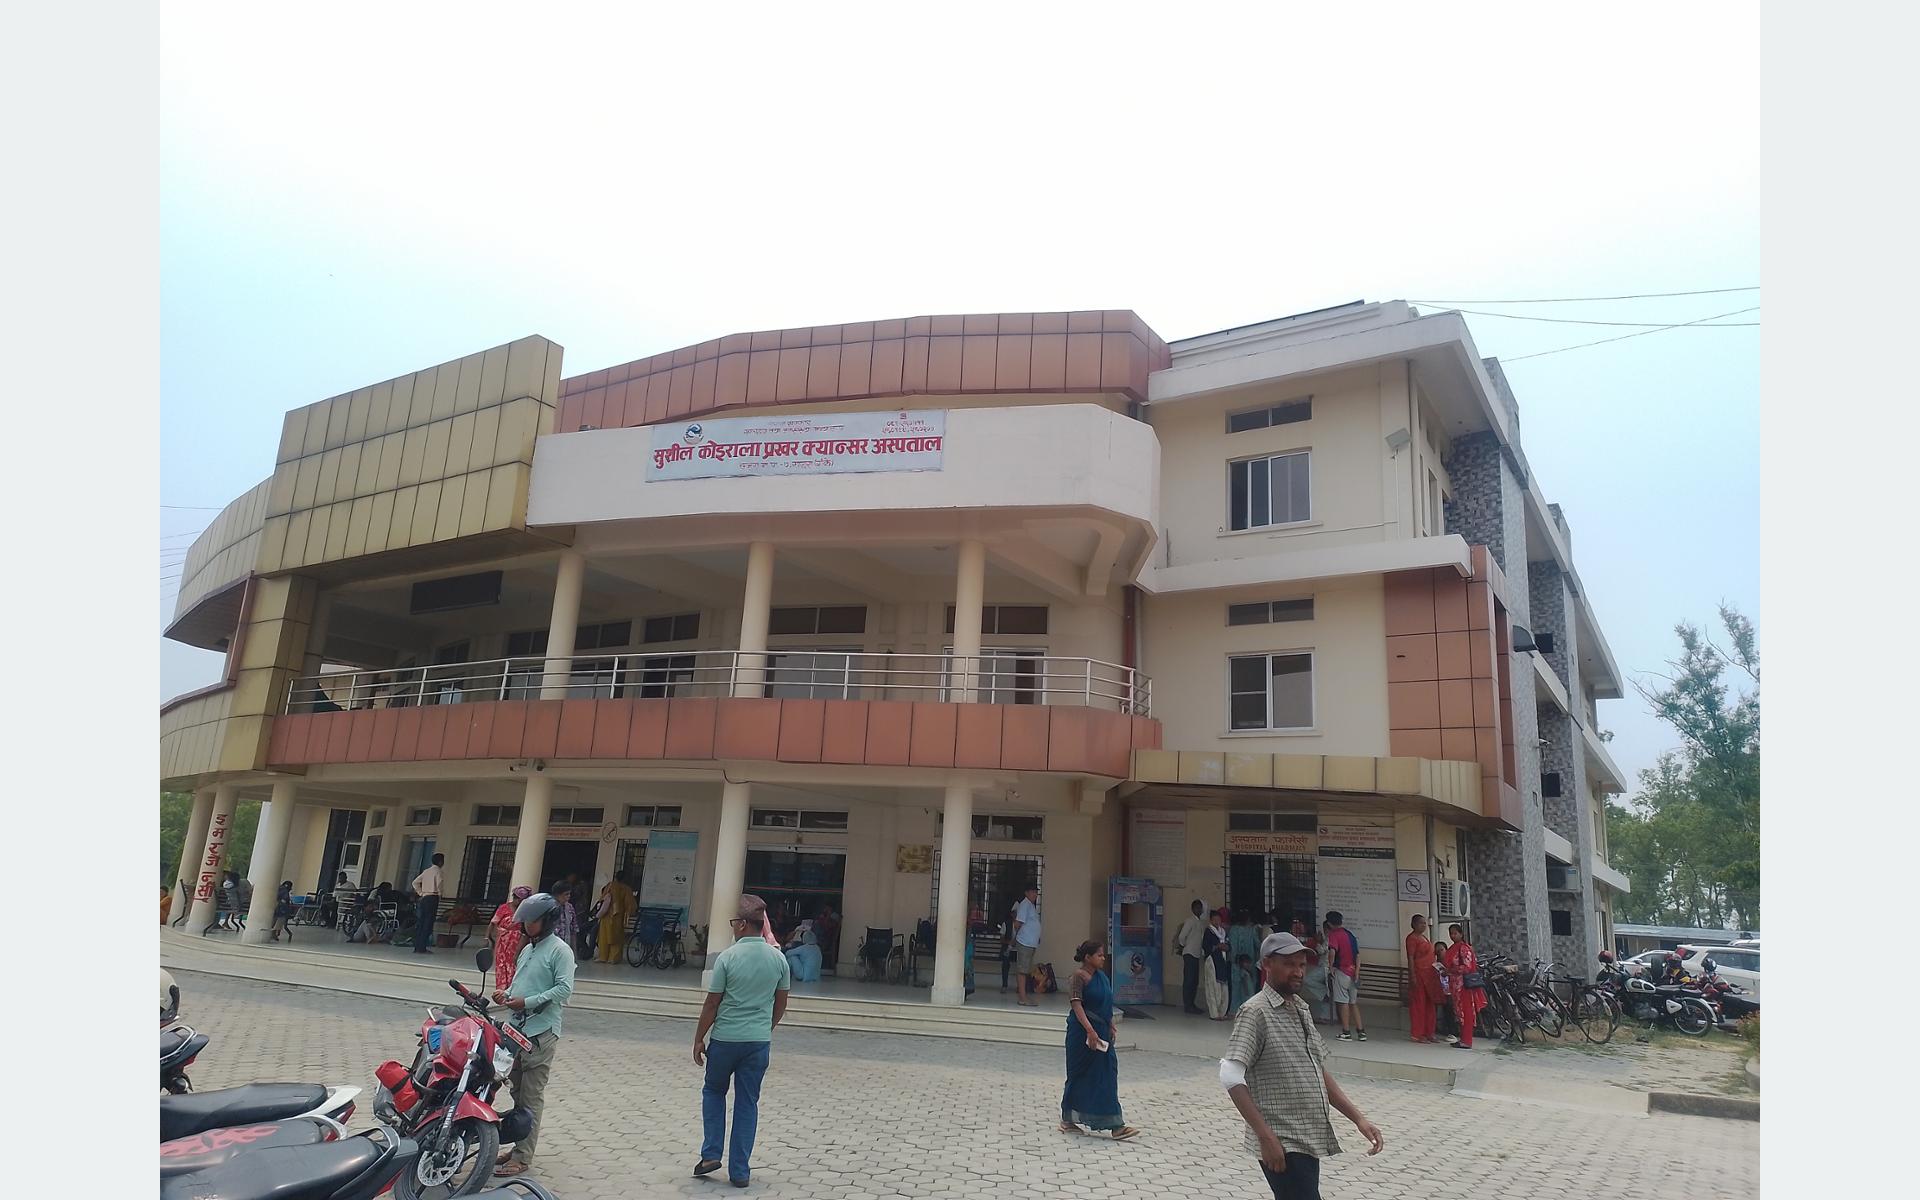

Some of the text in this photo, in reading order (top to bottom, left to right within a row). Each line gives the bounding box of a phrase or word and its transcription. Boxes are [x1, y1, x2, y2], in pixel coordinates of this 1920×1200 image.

[653, 436, 943, 469] सुशील कोइराला प्रखर क्यान्सर अस्पताल
